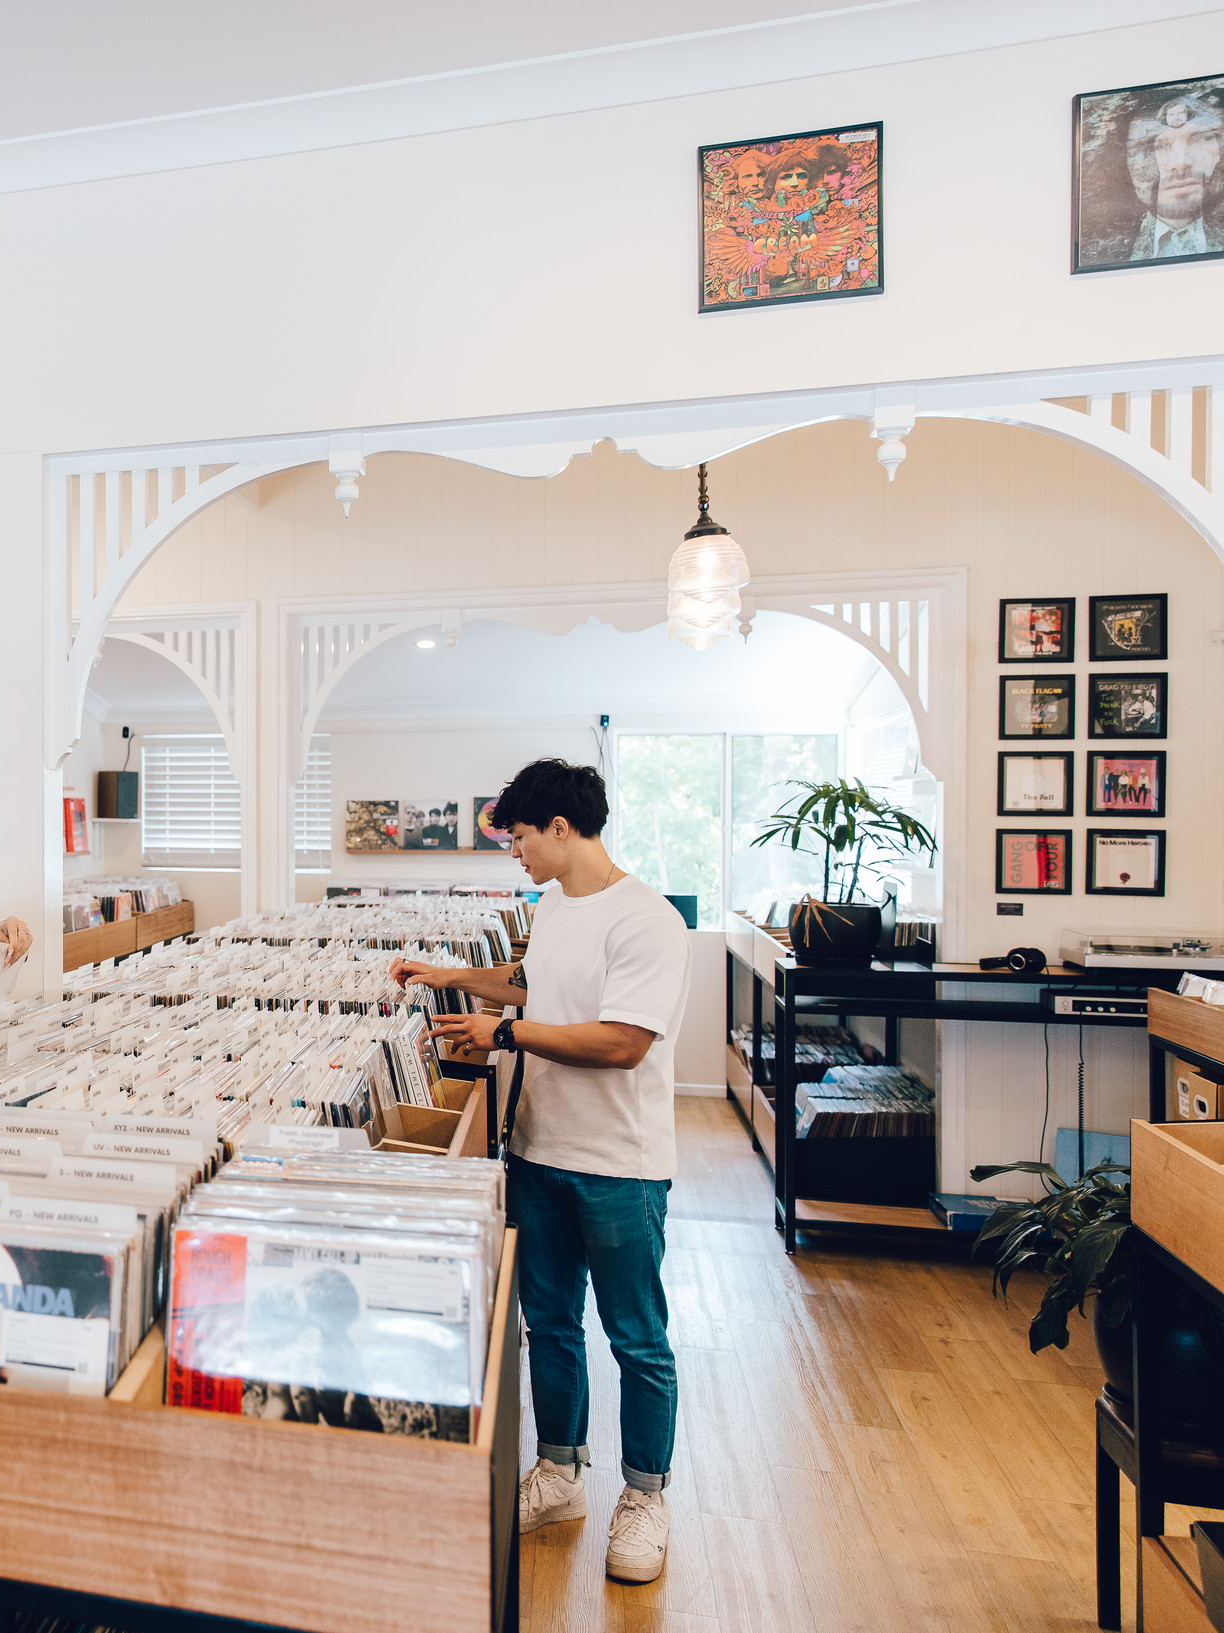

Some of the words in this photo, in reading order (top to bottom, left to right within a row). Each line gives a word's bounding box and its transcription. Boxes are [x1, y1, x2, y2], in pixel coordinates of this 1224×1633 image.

[754, 233, 817, 254] CREAM
[1036, 687, 1054, 695] FLAG
[1099, 683, 1119, 691] DEAD
[1023, 793, 1038, 801] The
[1040, 793, 1055, 801] Fall
[1010, 840, 1024, 884] GANG
[1045, 842, 1059, 880] FOUR
[25, 1127, 59, 1136] ARRIVALS
[155, 1127, 190, 1136] ARRIVALS
[279, 1129, 299, 1137] Fresh
[299, 1131, 334, 1139] Japanese
[113, 1145, 132, 1153] NEW
[134, 1147, 170, 1156] ARRIVALS
[74, 1170, 93, 1178] NEW
[96, 1172, 134, 1181] ARRIVALS
[33, 1211, 54, 1220] NEW
[56, 1213, 99, 1224] ARRIVALS
